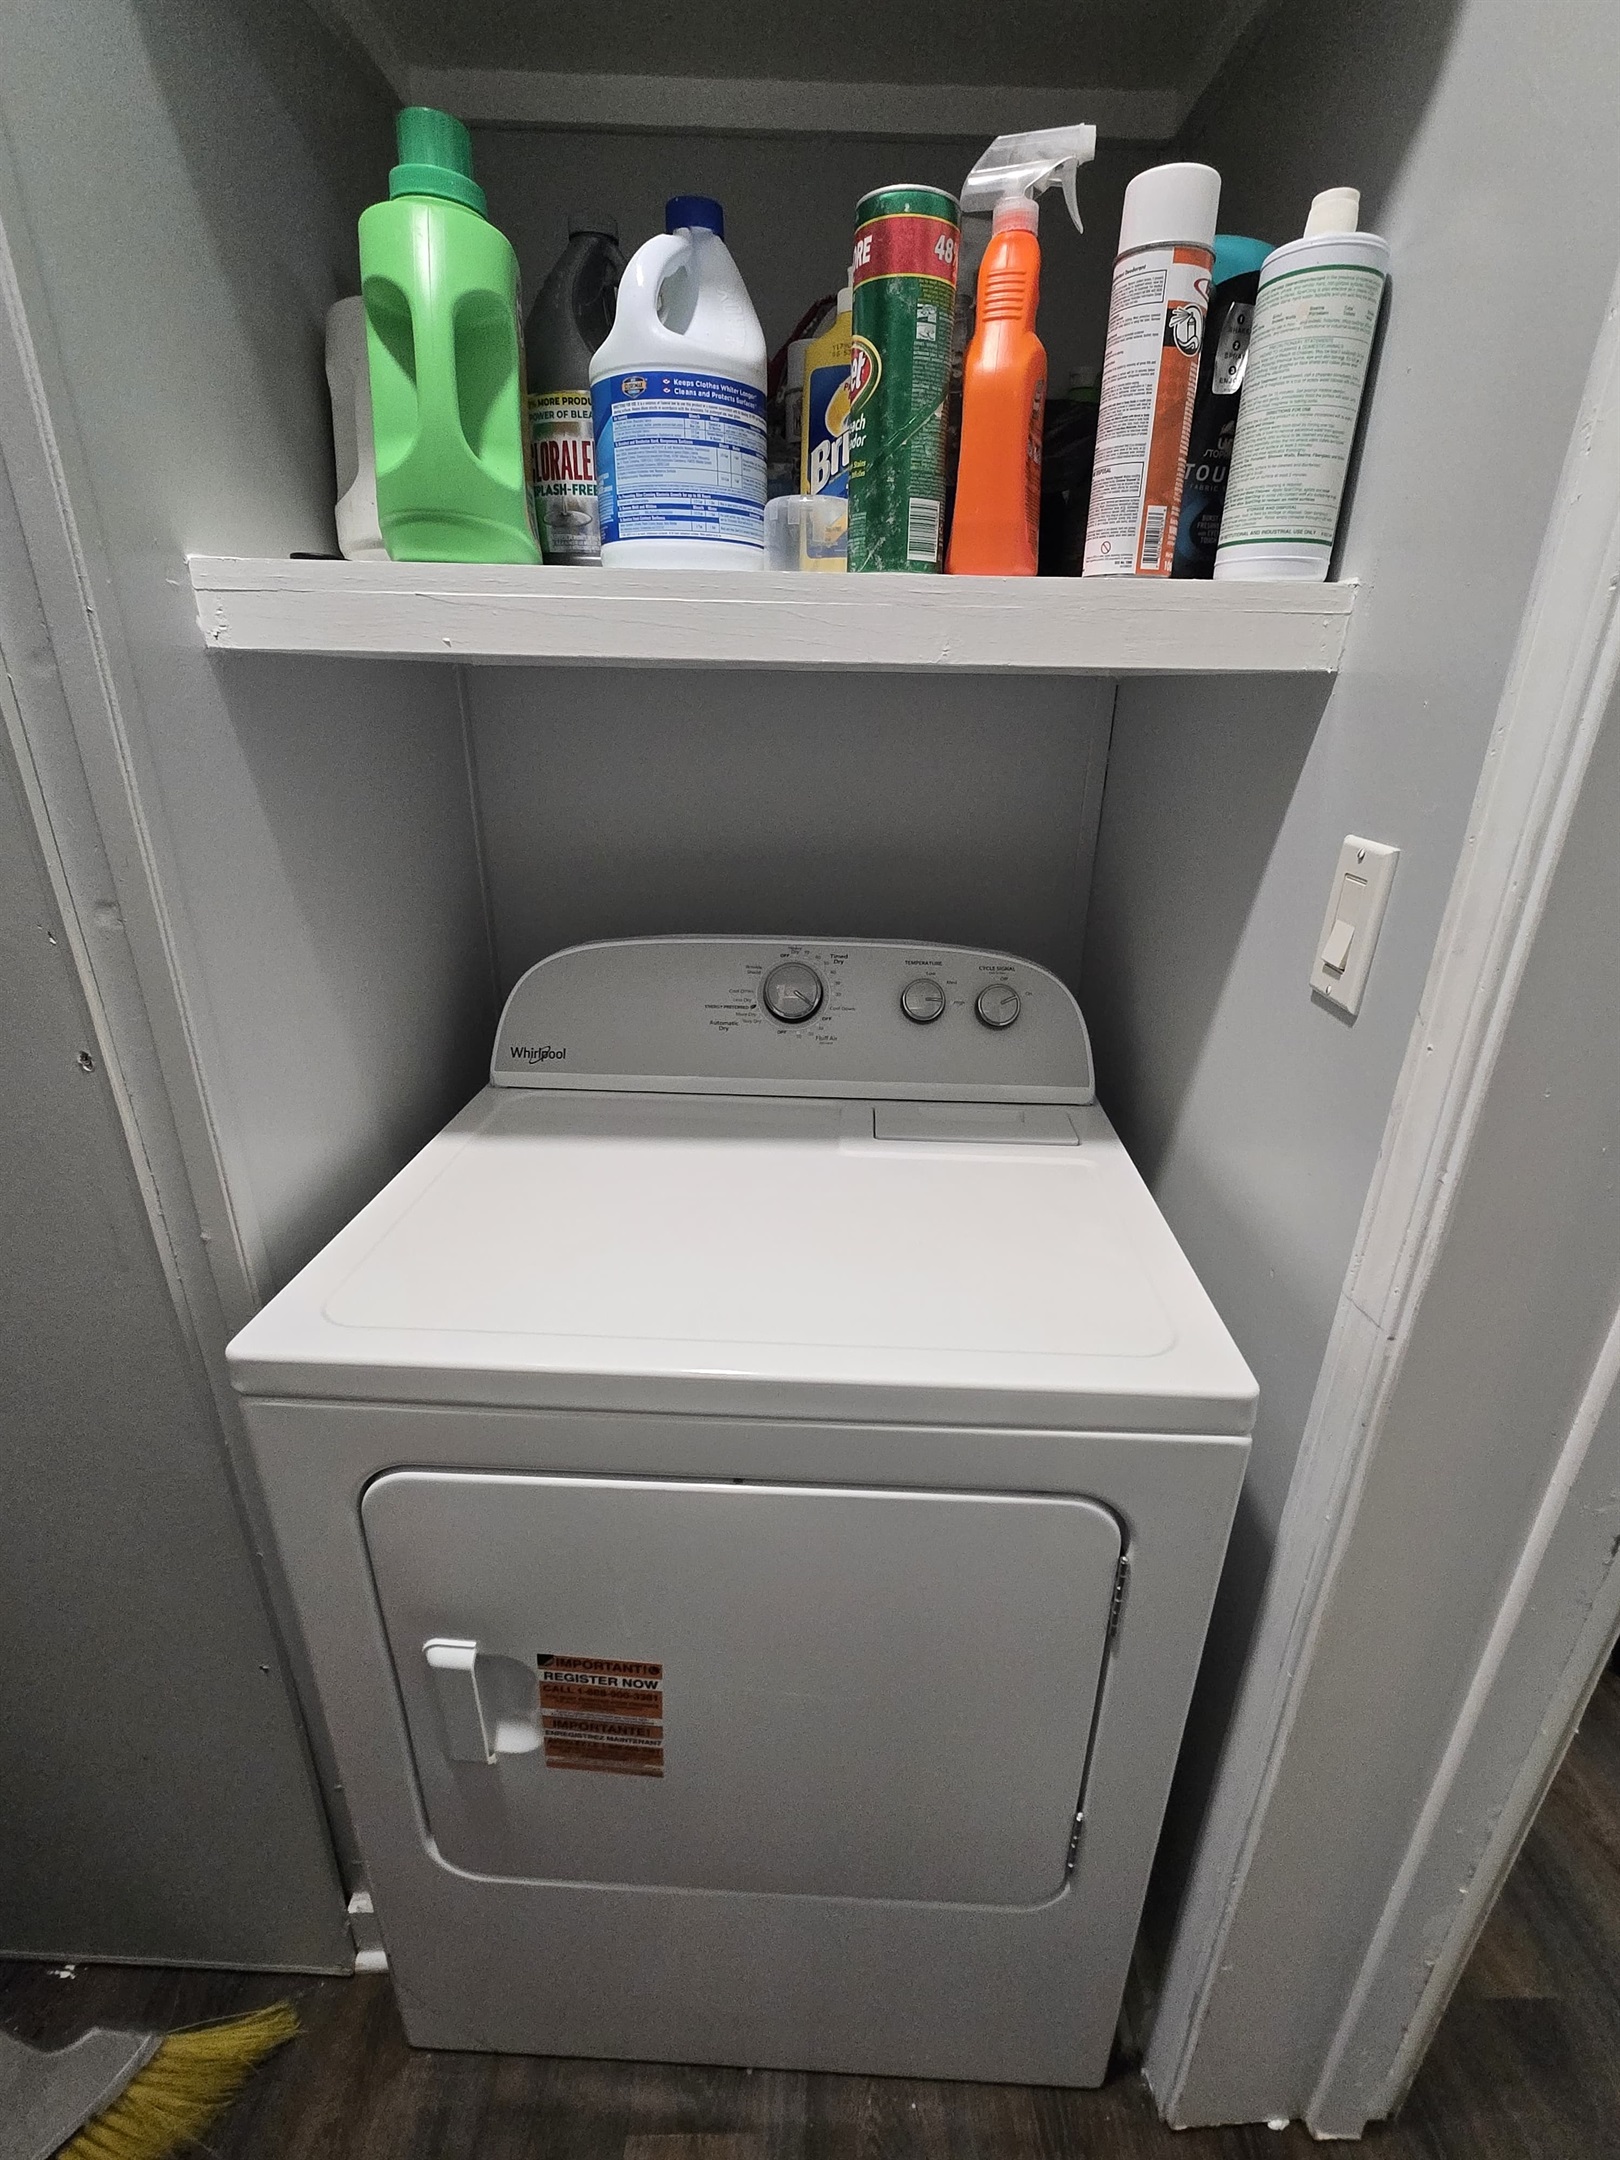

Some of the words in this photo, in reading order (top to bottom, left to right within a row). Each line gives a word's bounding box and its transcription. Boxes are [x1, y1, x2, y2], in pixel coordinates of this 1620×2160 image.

[673, 379, 694, 388] Keeps
[695, 381, 719, 390] Clothes
[721, 384, 739, 395] Whiter
[538, 397, 560, 406] MORE
[674, 388, 696, 396] Cleans
[712, 392, 735, 403] Protects
[904, 959, 942, 967] TEMPERATURE
[510, 1045, 566, 1064] Whirlpool
[543, 1671, 618, 1686] REGISTER
[622, 1678, 658, 1689] NOW
[543, 1684, 574, 1694] CALL
